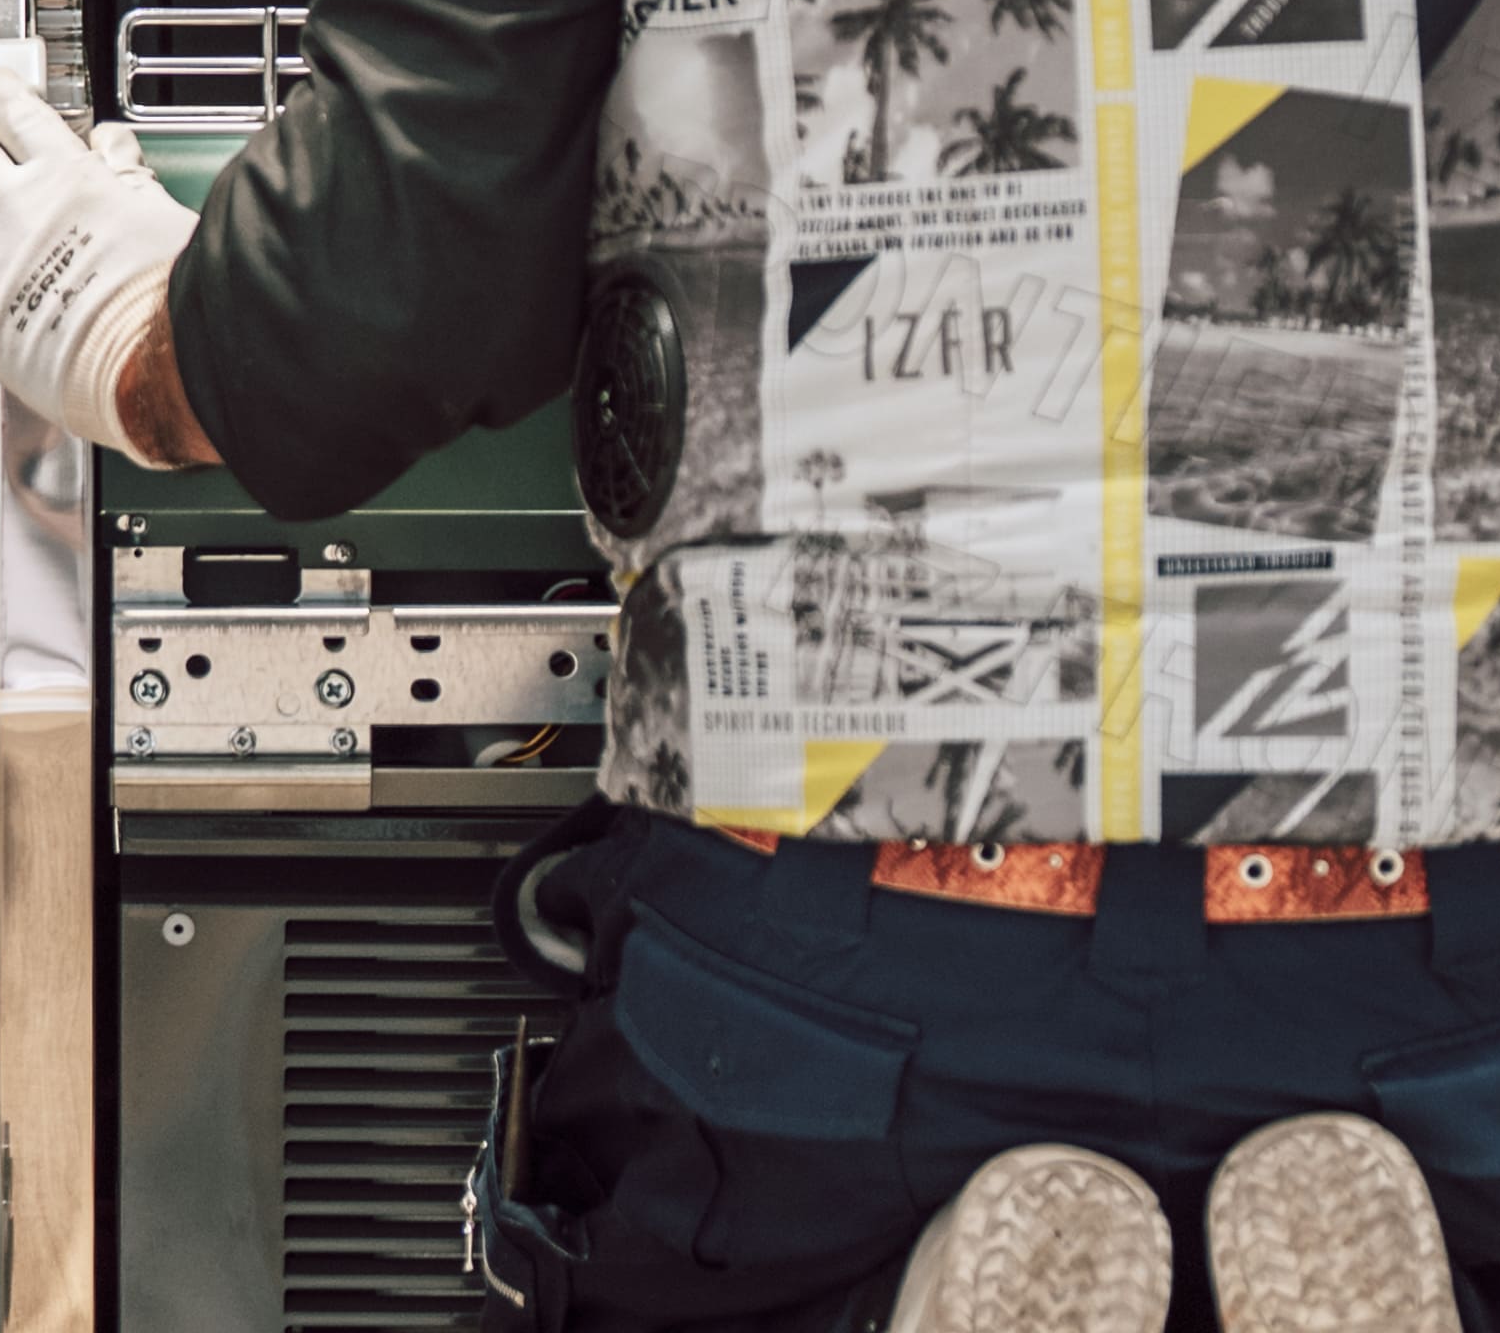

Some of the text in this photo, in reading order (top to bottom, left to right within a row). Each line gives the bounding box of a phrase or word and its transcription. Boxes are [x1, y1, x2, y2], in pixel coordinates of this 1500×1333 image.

[9, 224, 78, 316] ASSEMBLY
[27, 248, 75, 312] GRIP
[704, 710, 905, 733] SPIRIT AND TECHNIQUE
